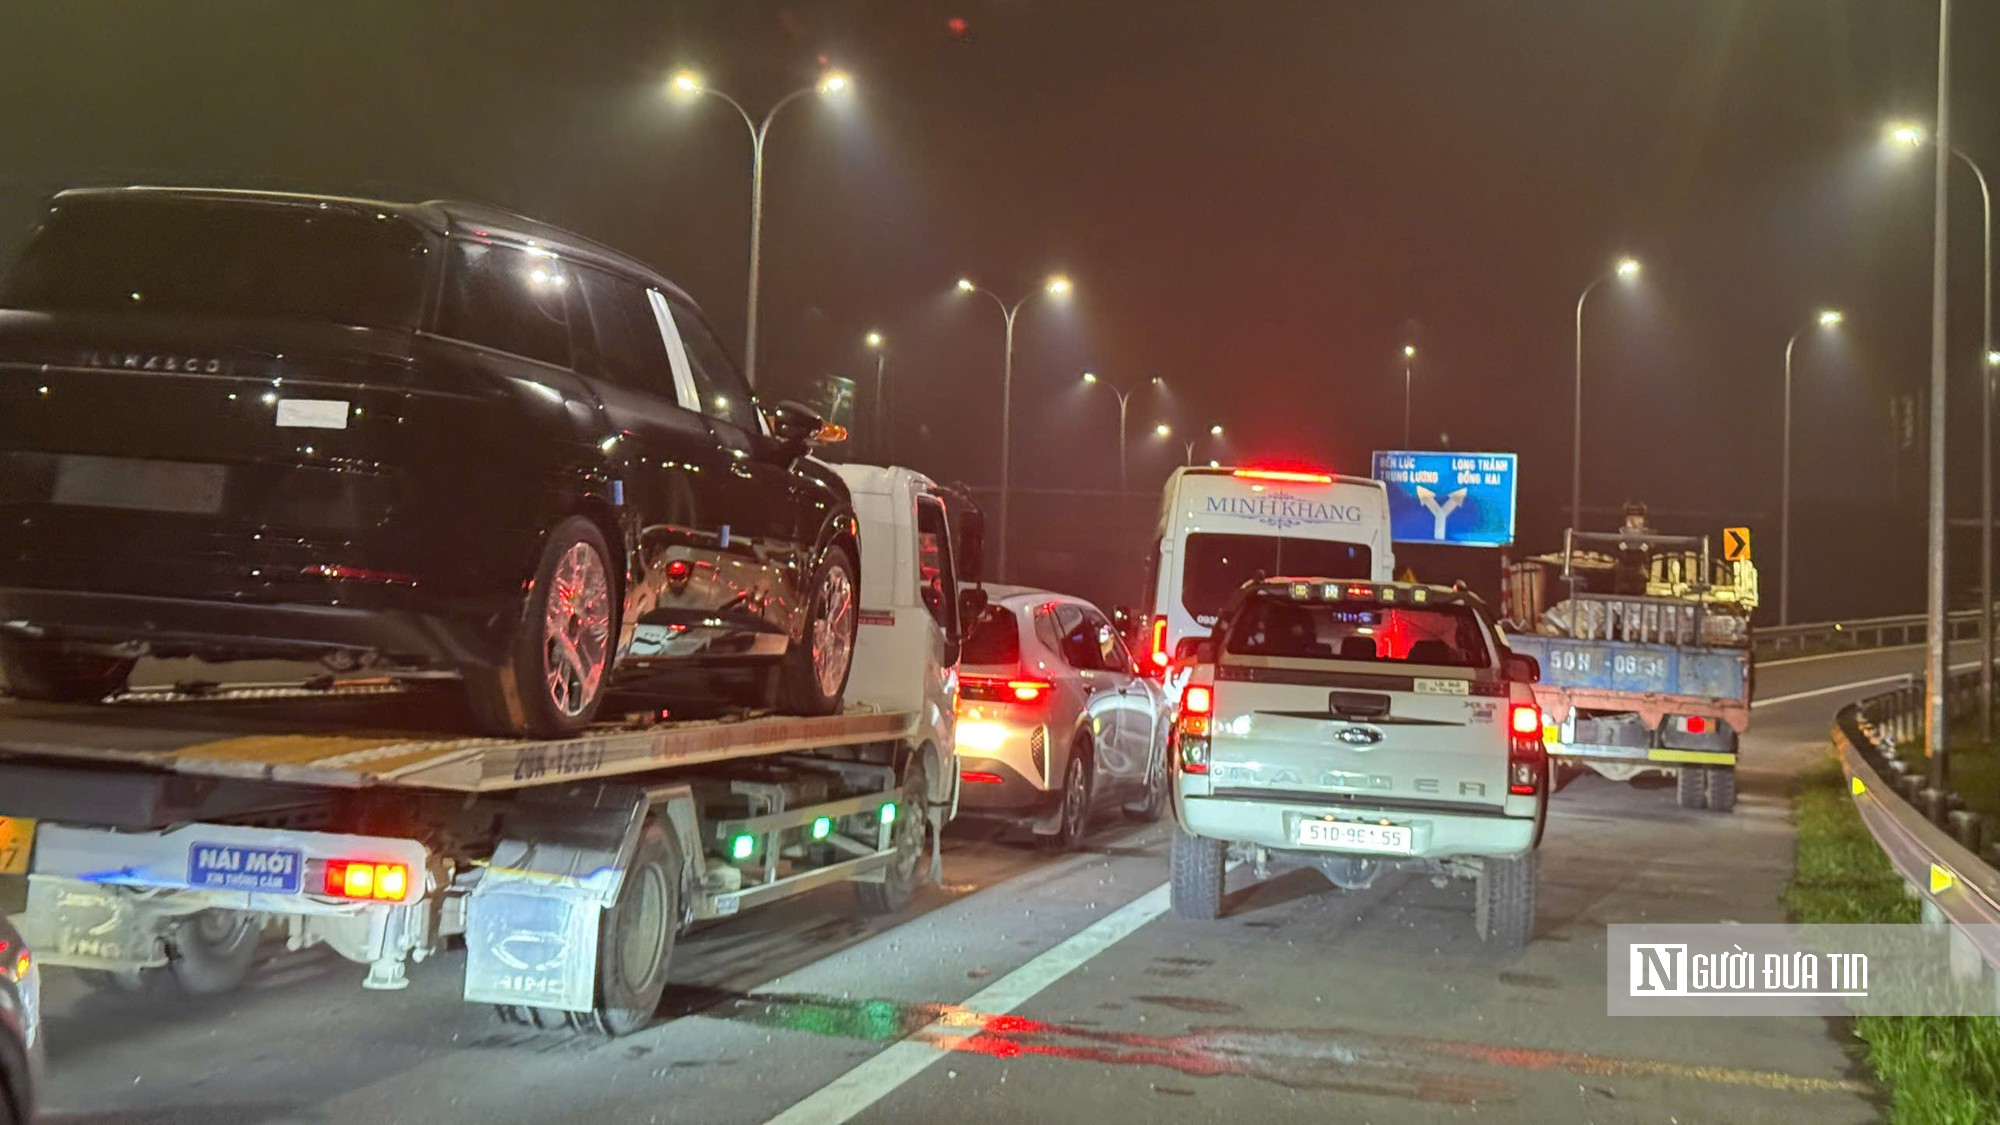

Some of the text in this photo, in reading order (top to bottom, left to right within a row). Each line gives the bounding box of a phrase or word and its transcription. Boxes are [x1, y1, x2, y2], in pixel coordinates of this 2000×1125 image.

[1452, 458, 1475, 470] LONG
[1485, 474, 1500, 485] NAI
[1206, 496, 1362, 522] MINH KHANG
